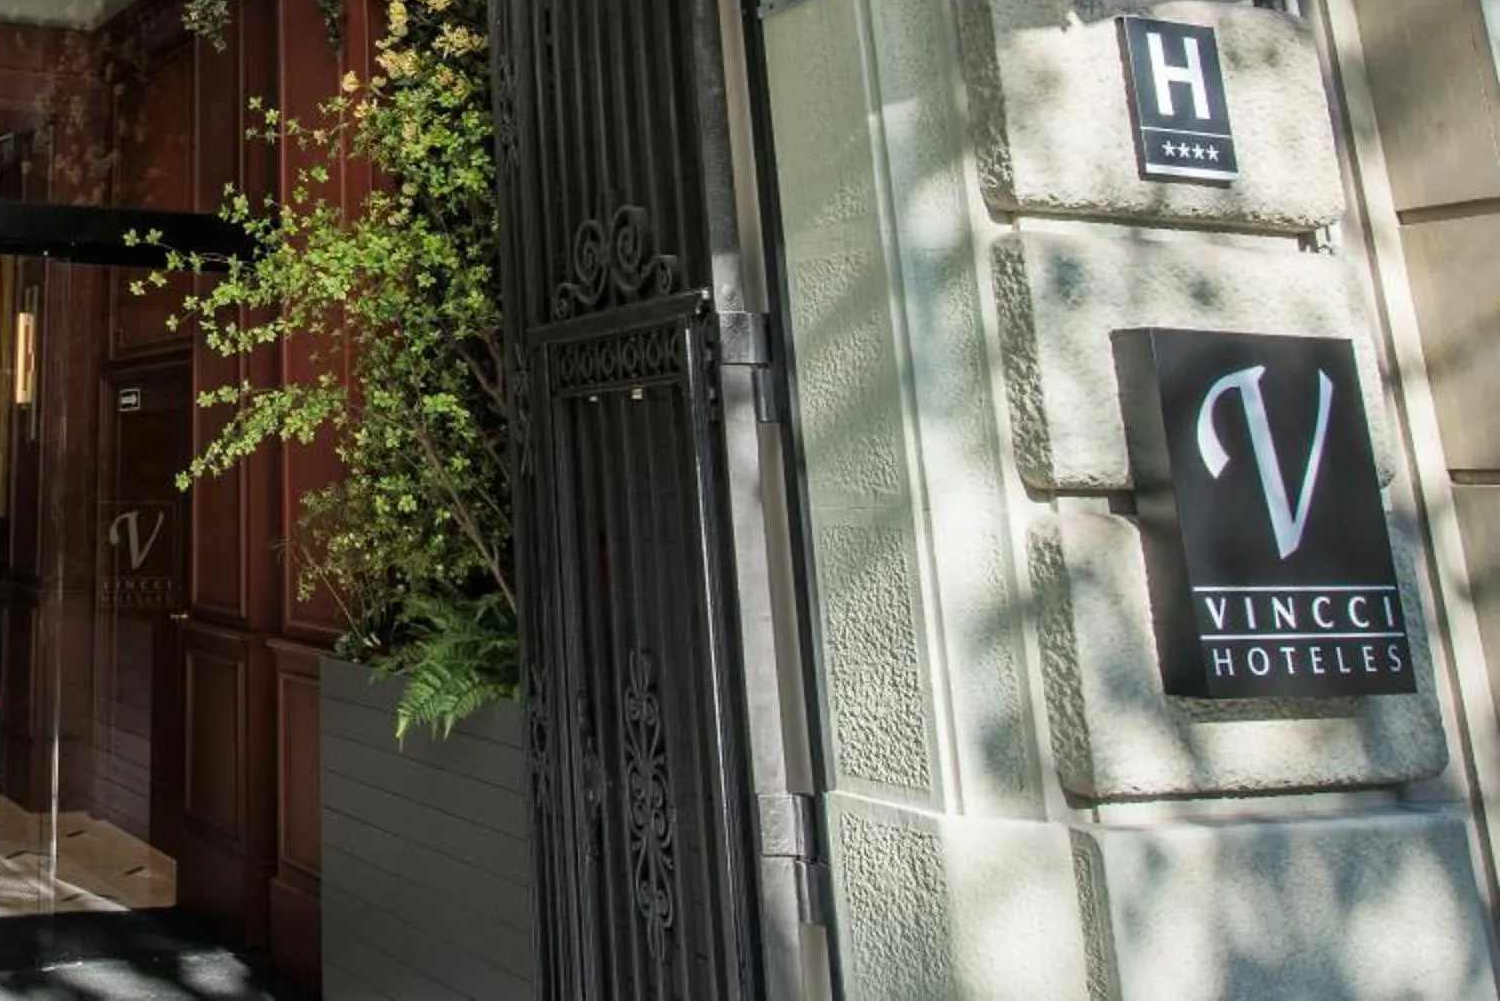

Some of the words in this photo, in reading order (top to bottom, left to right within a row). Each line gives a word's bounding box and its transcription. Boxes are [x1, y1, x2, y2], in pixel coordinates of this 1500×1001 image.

[1146, 32, 1211, 120] H
[1197, 364, 1334, 560] V
[109, 510, 165, 570] V
[1204, 596, 1399, 631] VINCCI
[1213, 645, 1402, 678] HOTELES
